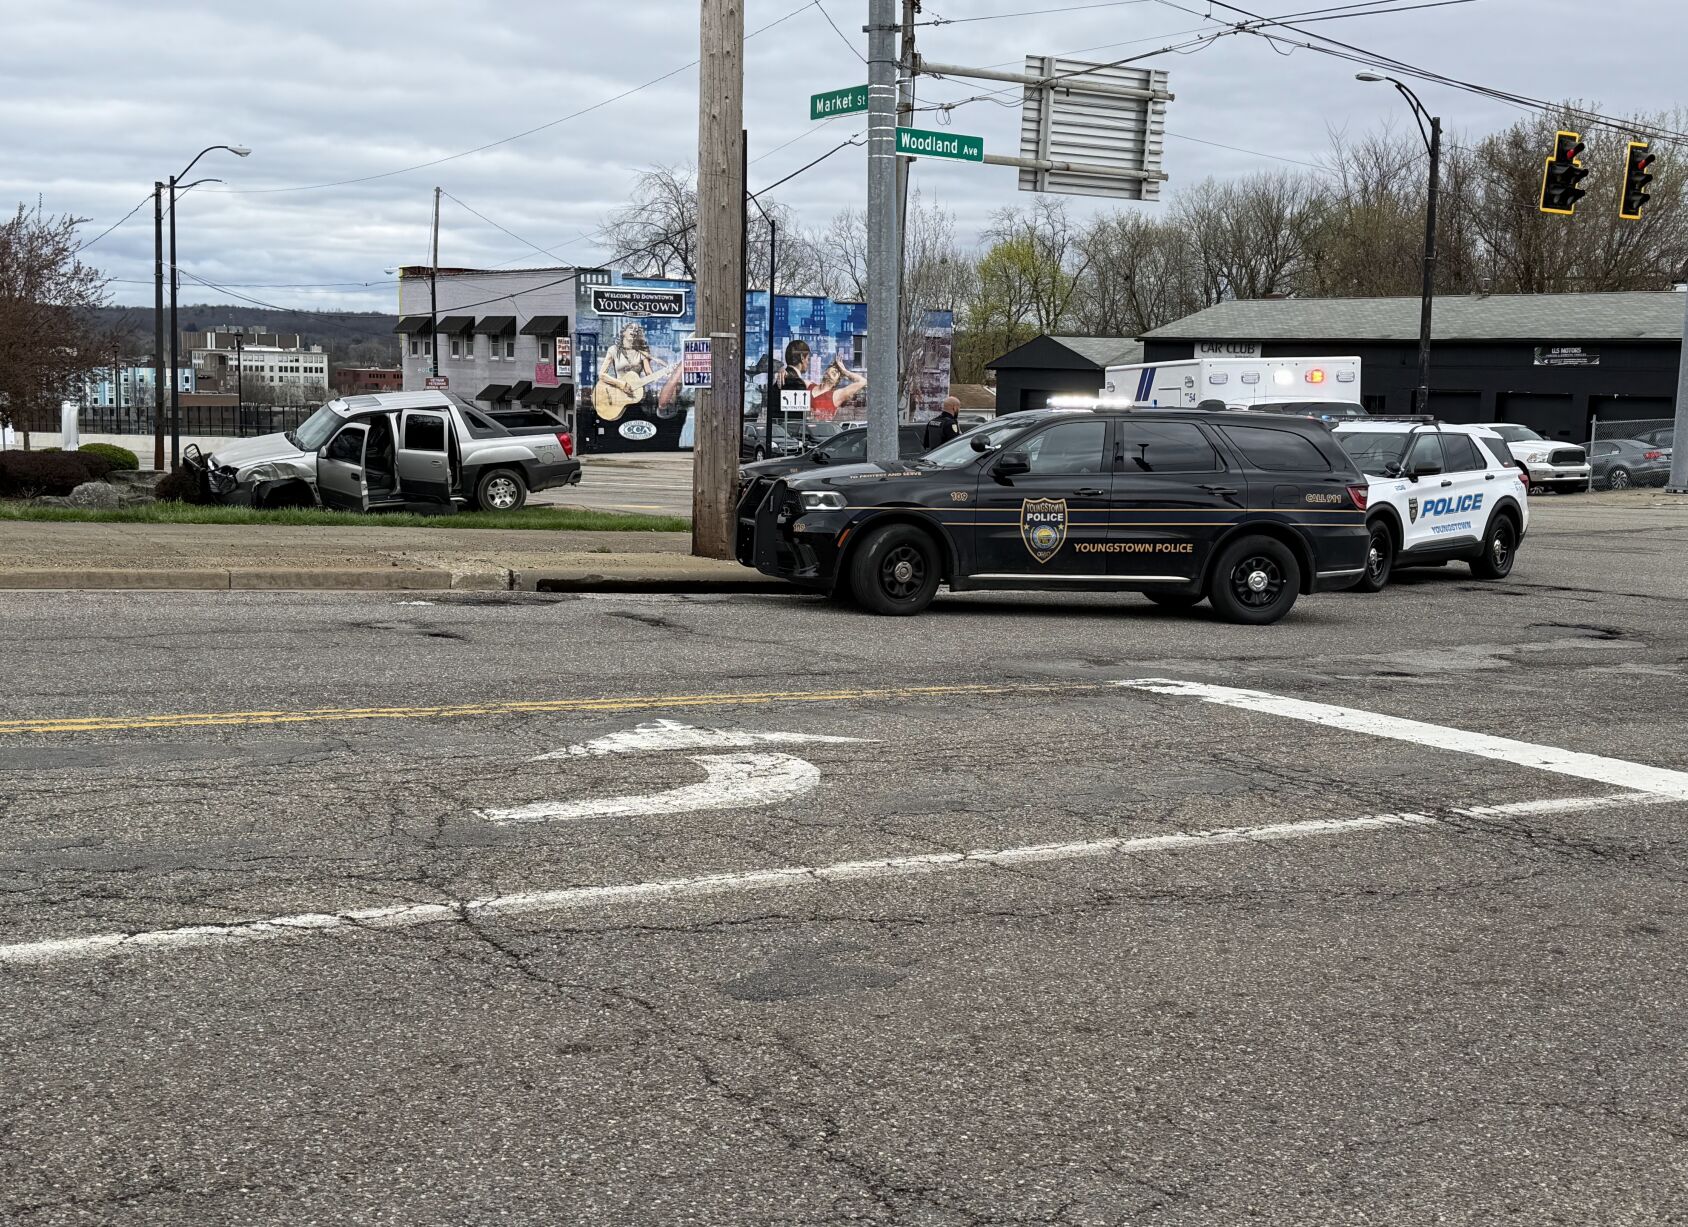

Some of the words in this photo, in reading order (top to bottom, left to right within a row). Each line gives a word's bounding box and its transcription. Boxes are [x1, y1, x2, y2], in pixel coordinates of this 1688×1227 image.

[816, 95, 852, 114] Market
[857, 95, 866, 106] St
[901, 132, 958, 154] Woodland
[963, 145, 978, 156] Ave
[598, 298, 680, 312] YOUNGSTOWN
[684, 341, 711, 353] HEALTH
[1200, 342, 1223, 354] CAR
[1226, 342, 1255, 354] CLUB
[1188, 393, 1196, 403] 54
[951, 491, 968, 502] 109
[1305, 493, 1327, 503] CALL
[1326, 494, 1342, 504] 911
[1026, 503, 1064, 513] YOUNGSTOWN
[1420, 492, 1484, 519] POLICE
[1026, 512, 1064, 522] POLICE
[1431, 521, 1472, 534] YOUNGSTOWN
[1074, 543, 1153, 553] YOUNGSTOWN
[1155, 543, 1194, 553] POLICE
